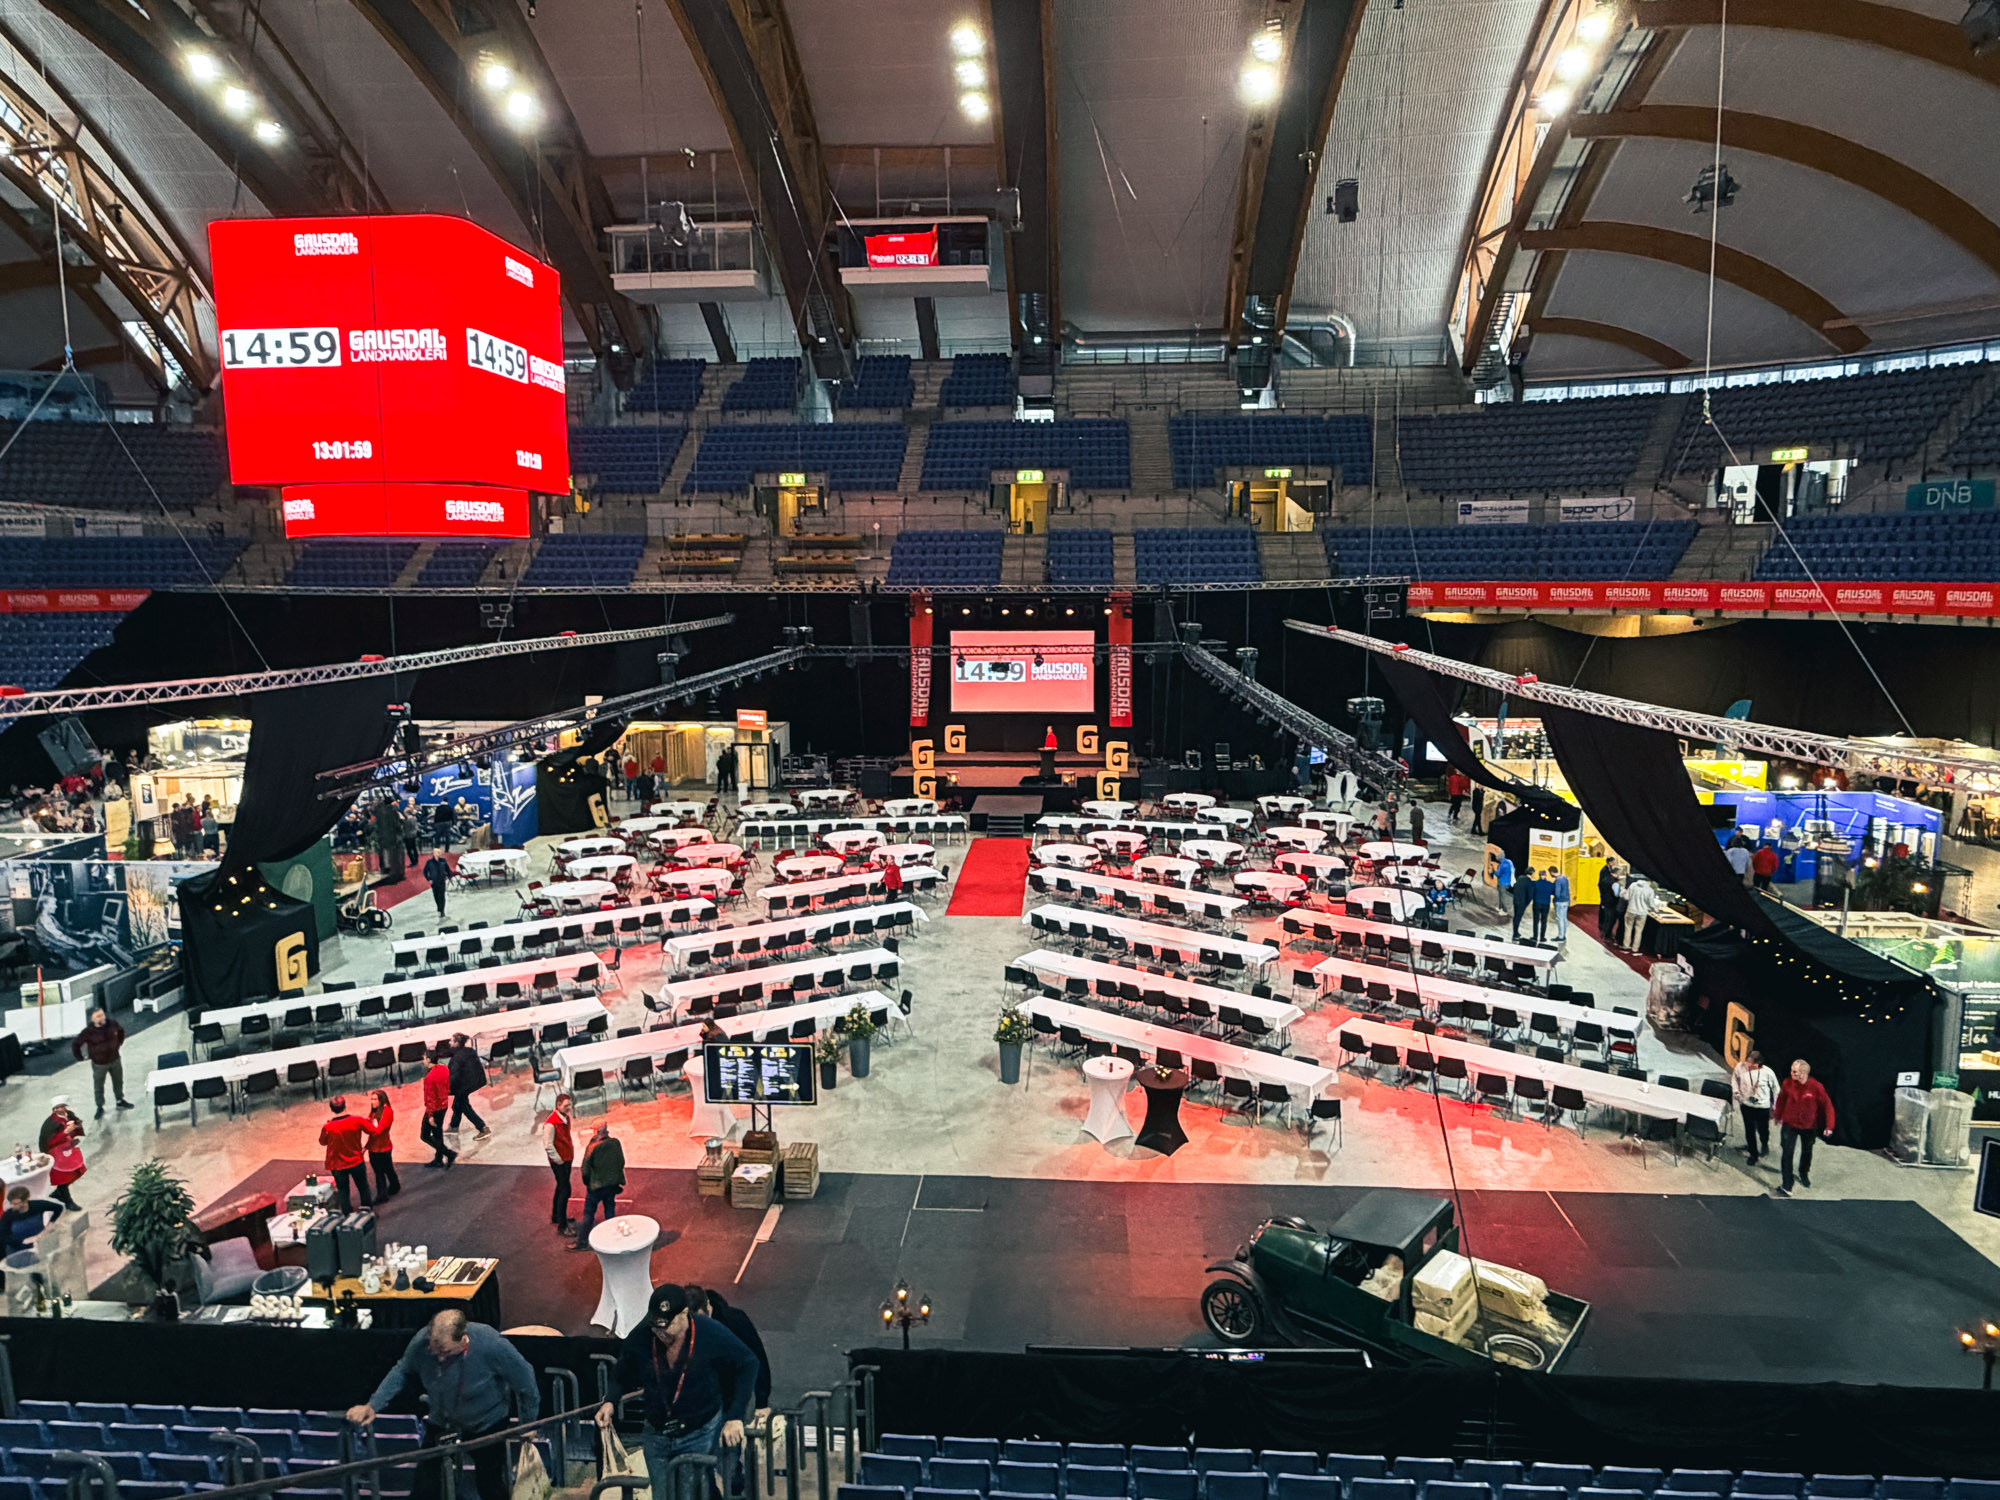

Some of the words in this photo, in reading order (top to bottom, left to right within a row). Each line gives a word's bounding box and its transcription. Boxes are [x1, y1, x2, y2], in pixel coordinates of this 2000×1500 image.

[294, 233, 358, 248] GAUSDAL
[295, 246, 358, 256] LANDHANDLERI
[224, 330, 338, 365] 14:59
[349, 329, 447, 350] GAUSDAL
[350, 348, 447, 362] LANDHANDLERI
[469, 332, 526, 380] 14:59
[312, 440, 373, 460] 13:01:59
[1926, 481, 1972, 510] DNB
[446, 500, 504, 515] GAUSDAL
[1445, 587, 1487, 595] GAUSDAL
[1496, 587, 1538, 596] GAUSDAL
[1551, 587, 1593, 596] GAUSDAL
[1606, 587, 1651, 597] GAUSDAL
[1664, 587, 1709, 597] GAUSDAL
[1720, 588, 1765, 598] GAUSDAL
[1836, 589, 1882, 599] GAUSDAL
[1892, 590, 1936, 600] GAUSDAL
[1946, 591, 1993, 601] GAUSDAL
[1031, 663, 1087, 674] GAUSDAL
[1031, 673, 1087, 681] LANDHANDLERI
[944, 725, 967, 754] G
[1077, 725, 1099, 754] G
[912, 739, 935, 770] G
[1105, 741, 1129, 772] G
[913, 770, 937, 799] G
[1097, 771, 1121, 801] G
[275, 931, 309, 991] G
